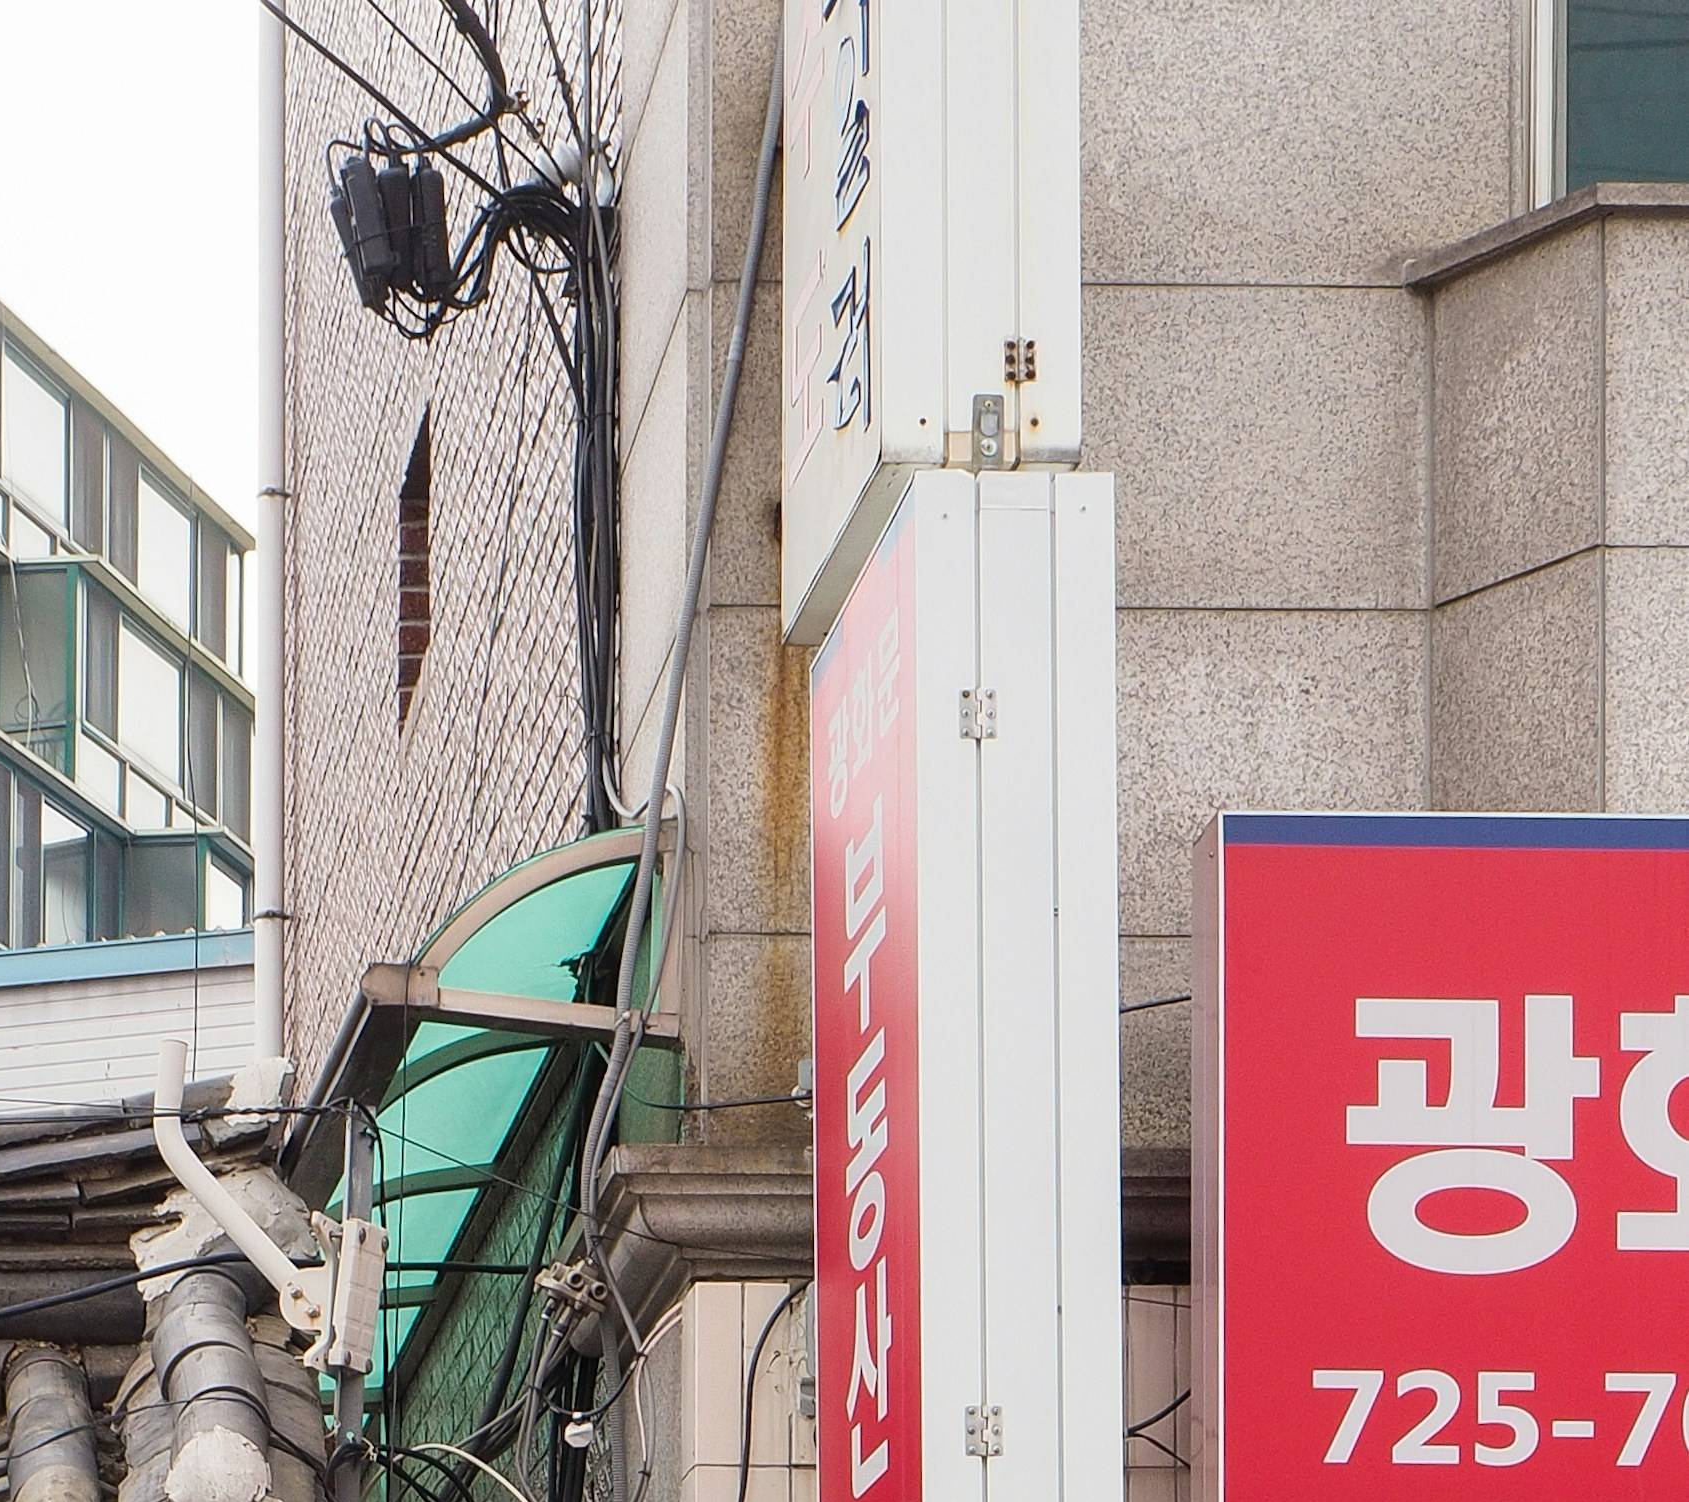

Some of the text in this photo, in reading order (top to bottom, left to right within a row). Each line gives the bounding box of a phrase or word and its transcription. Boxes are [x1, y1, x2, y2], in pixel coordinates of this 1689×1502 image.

[827, 605, 901, 820] 광화문
[843, 793, 894, 1501] 부동산
[1312, 1369, 1689, 1467] 725-7
